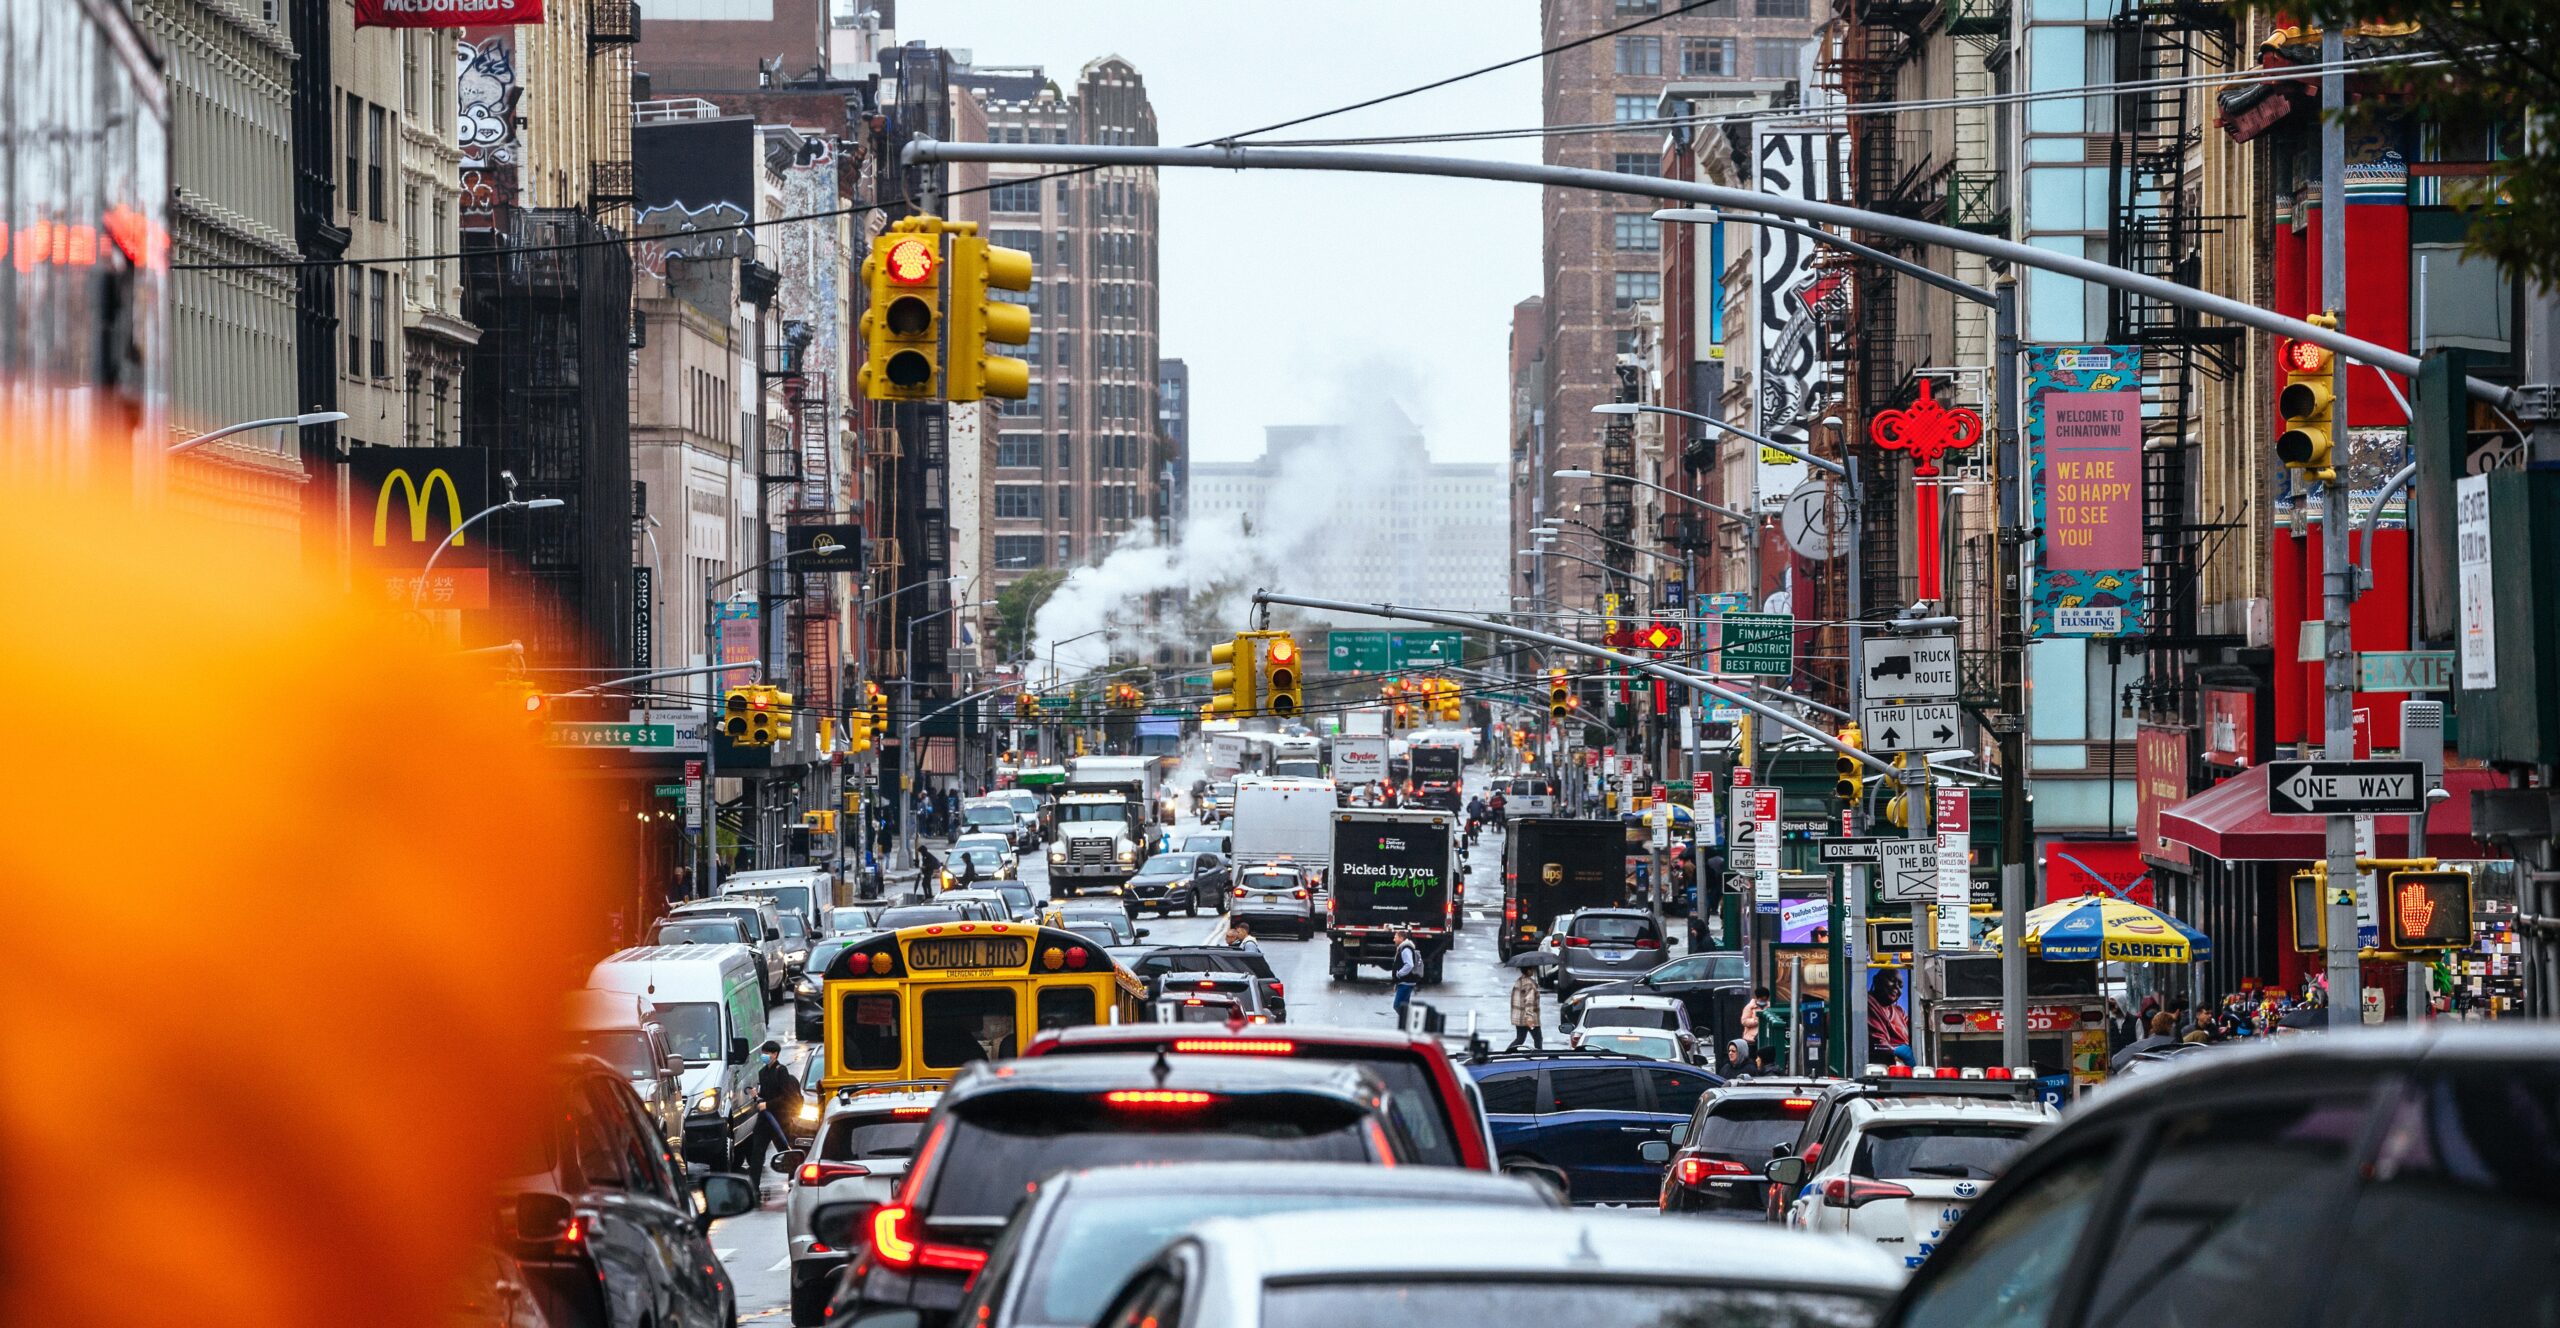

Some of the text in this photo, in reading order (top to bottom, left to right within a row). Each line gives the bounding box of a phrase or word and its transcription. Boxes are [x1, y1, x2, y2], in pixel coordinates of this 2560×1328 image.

[2056, 409, 2124, 422] WELCOME TO
[2056, 425, 2121, 437] CHINATOWN!
[2056, 461, 2115, 479] WE ARE
[2057, 483, 2131, 502] SO HAPPY
[2057, 505, 2109, 524] TO SEE
[2058, 528, 2093, 546] YOU!
[2061, 617, 2115, 627] FLUSHING
[1738, 629, 1791, 641] FINANCIAL
[1748, 643, 1790, 654] DISTRICT
[1913, 650, 1951, 662] TRUCK
[1725, 660, 1787, 671] BEST ROUTE
[2363, 657, 2450, 686] BAXTE
[1915, 671, 1952, 683] ROUTE
[1874, 708, 1954, 722] THRU LOCAL
[637, 728, 657, 742] St
[1349, 751, 1378, 761] Ryder
[2293, 778, 2404, 798] ONE WAY
[1738, 821, 1755, 843] 2
[1781, 822, 1828, 831] Street Stati
[1939, 835, 1945, 847] 3
[1831, 845, 1880, 855] ONE WA
[1886, 844, 1938, 855] DON'T BLO
[1898, 857, 1938, 868] THE BO
[1343, 863, 1434, 878] Picked by you
[1544, 869, 1562, 882] ups
[1374, 875, 1409, 895] packed
[1413, 876, 1425, 897] by
[1791, 907, 1812, 919] YouTube
[1938, 906, 1945, 918] 5
[2108, 915, 2154, 928] SABRETT
[1889, 931, 1914, 943] ONE
[915, 940, 1018, 966] SCHOOL BUS
[2109, 943, 2185, 958] SABRETT
[946, 969, 978, 978] EMERGENCY
[2363, 1004, 2377, 1012] NY
[1810, 1011, 1818, 1024] P
[1997, 1018, 2052, 1030] FOD
